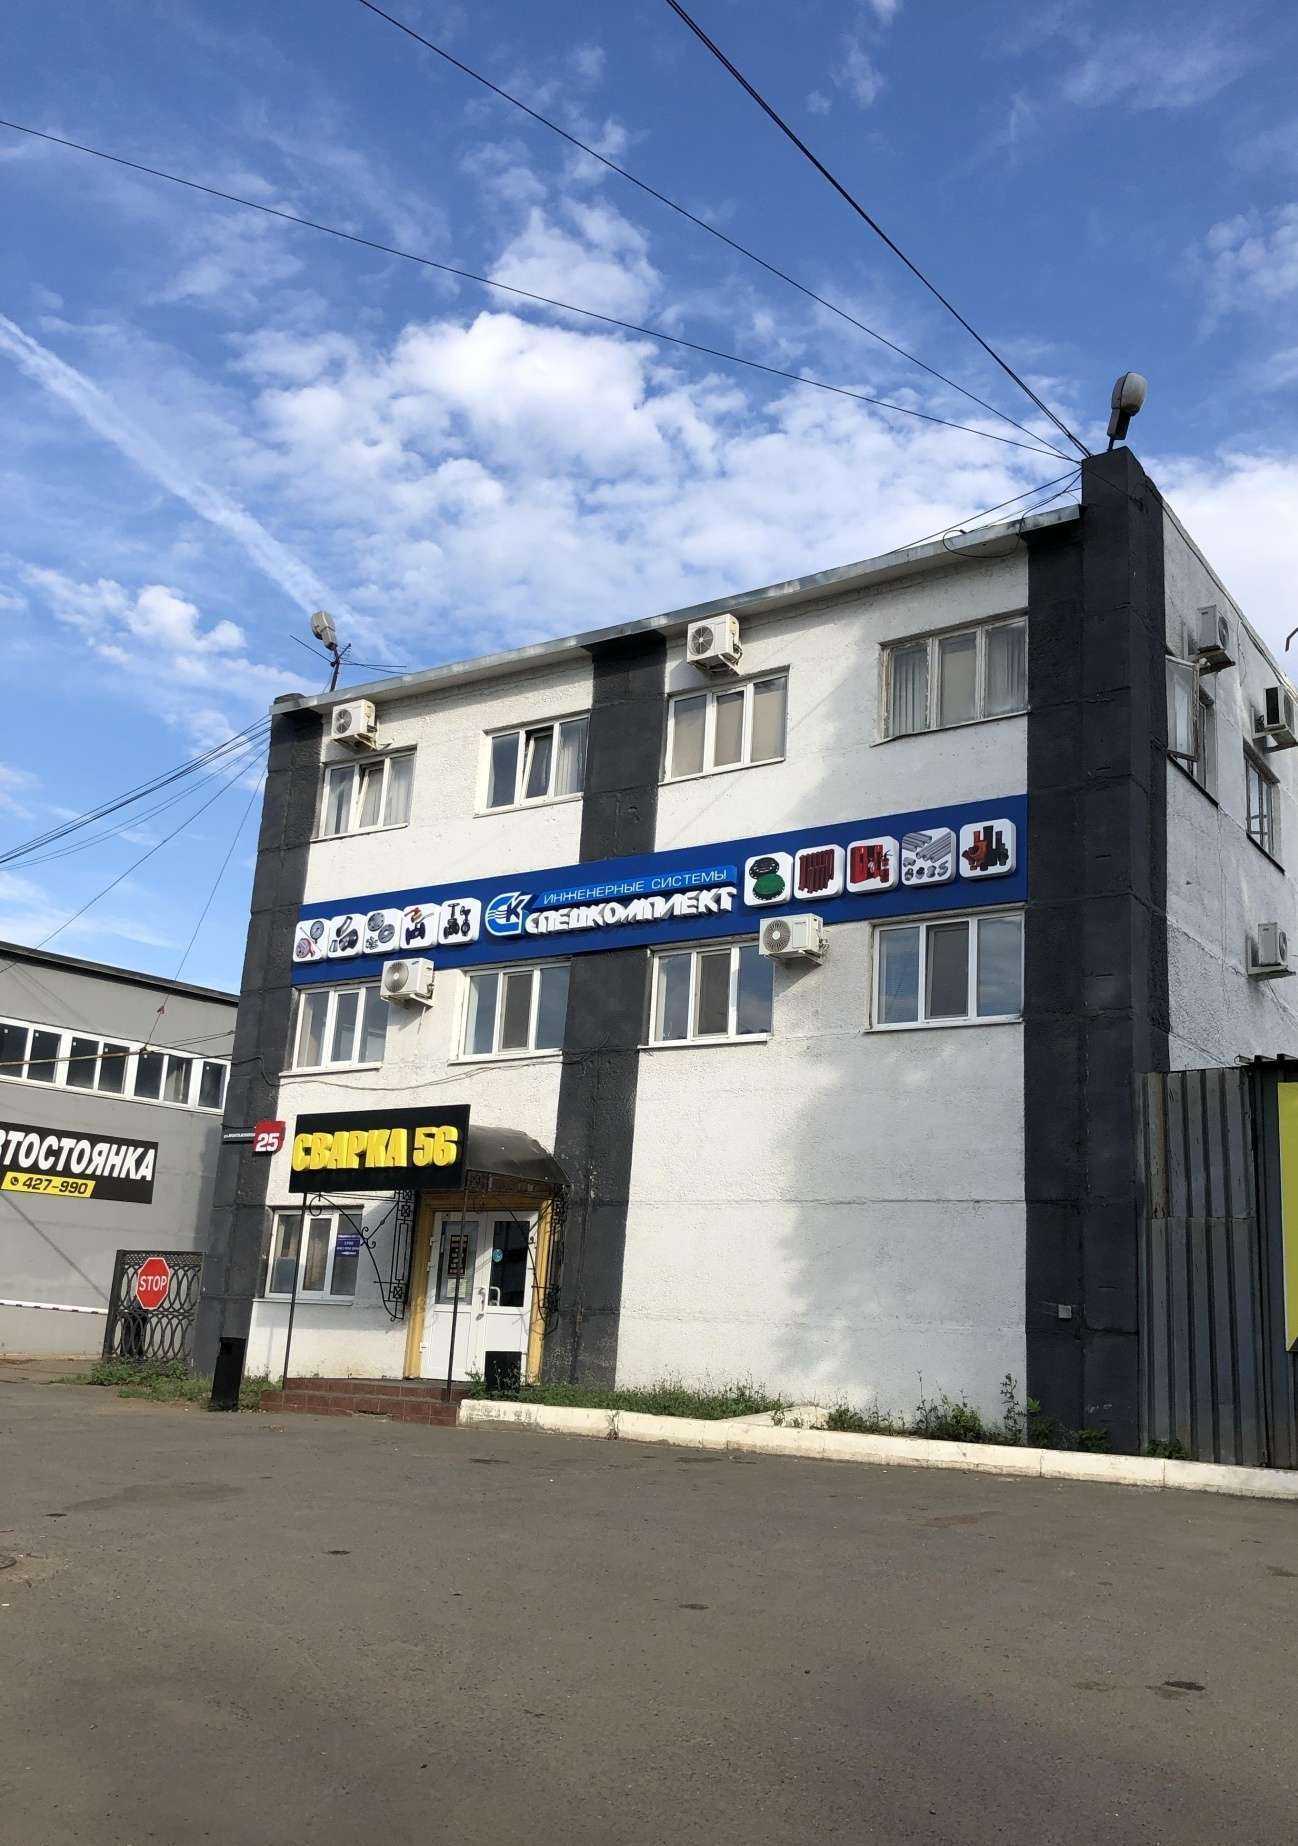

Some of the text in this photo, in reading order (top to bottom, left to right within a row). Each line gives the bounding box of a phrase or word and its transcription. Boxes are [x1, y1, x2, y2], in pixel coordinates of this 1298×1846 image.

[543, 869, 727, 905] ИНЖЕНЕРНЫЕ СИСТЕМЫ
[525, 886, 737, 934] СПЕЦКОМПЛЕКТ
[255, 1132, 280, 1152] 25
[292, 1125, 459, 1171] СВАРКА 56
[22, 1176, 89, 1195] 427-990
[138, 1275, 168, 1292] STOP
